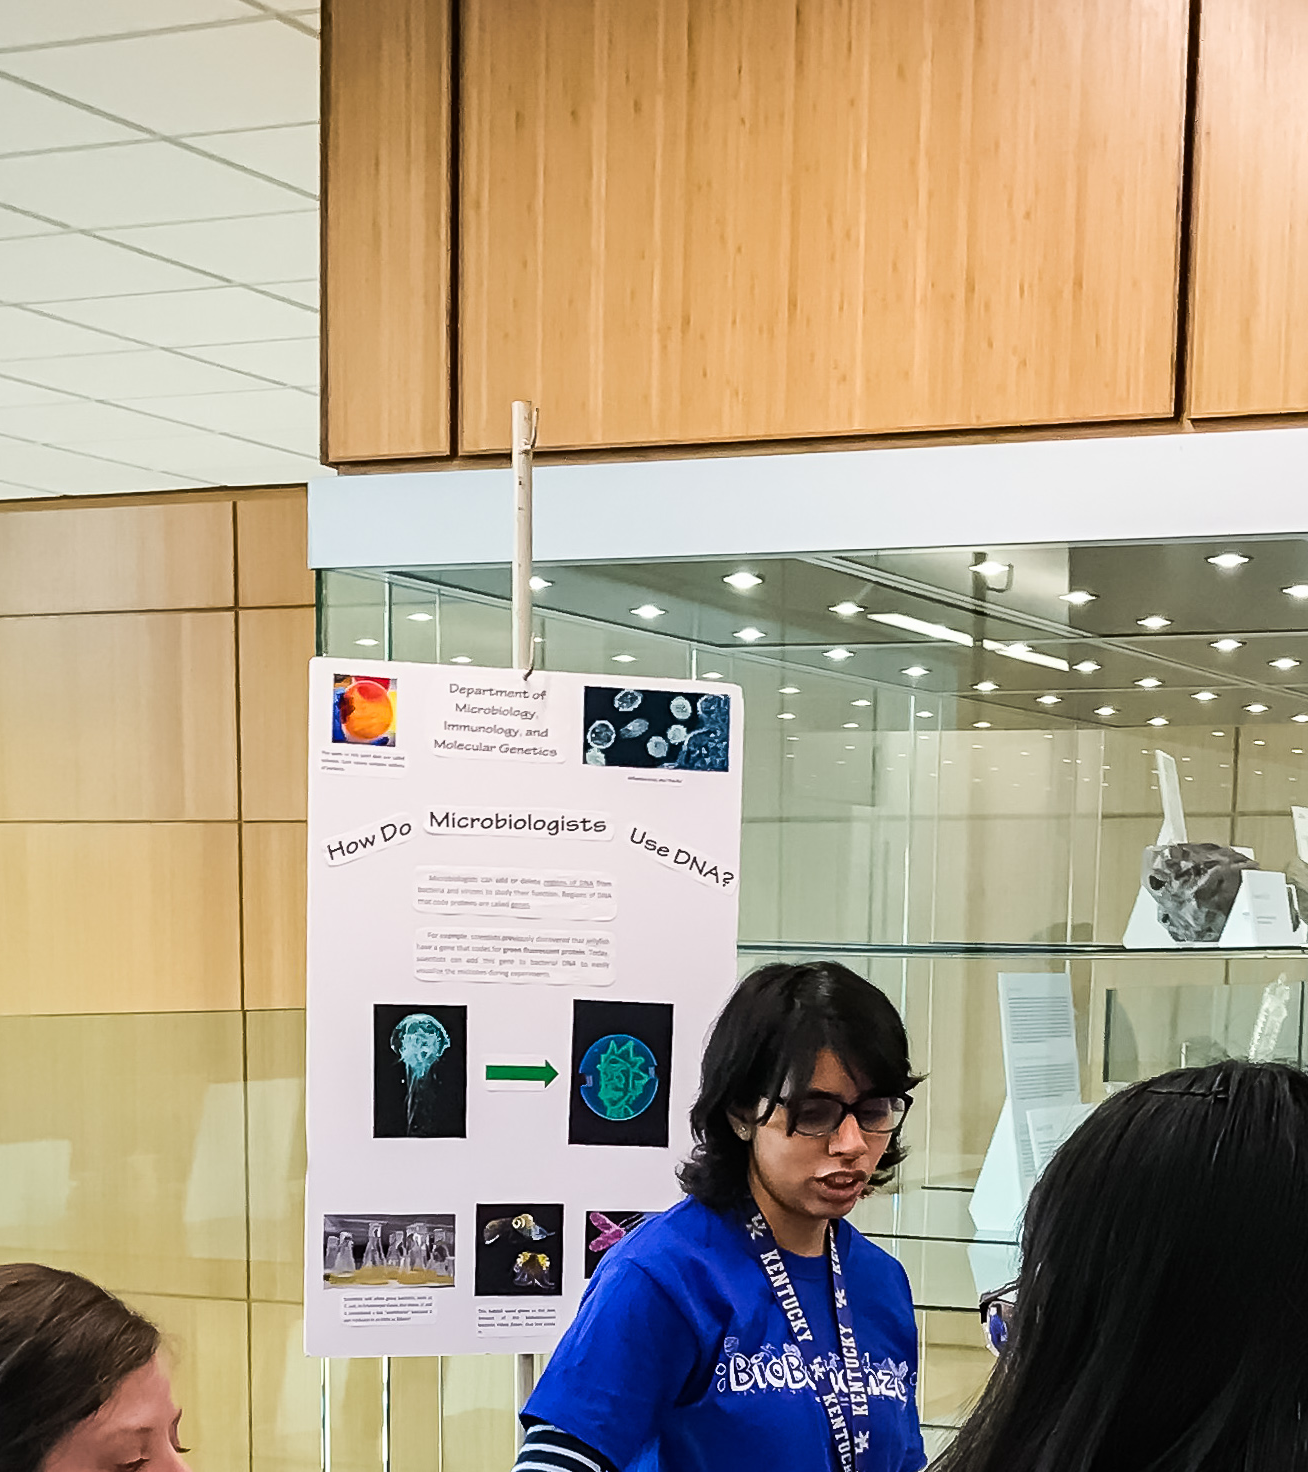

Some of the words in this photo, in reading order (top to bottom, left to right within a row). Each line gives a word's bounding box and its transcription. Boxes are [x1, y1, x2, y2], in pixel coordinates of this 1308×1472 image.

[449, 683, 529, 699] Department
[532, 689, 547, 700] of
[455, 703, 539, 720] Microbiology,
[443, 720, 523, 738] Immunology,
[525, 728, 549, 738] and
[433, 739, 496, 752] Molecular
[499, 743, 558, 757] Genetics
[326, 830, 376, 862] How
[380, 819, 413, 846] Do
[429, 810, 607, 836] Microbiologists
[629, 826, 670, 858] Use
[672, 848, 735, 889] DNA?
[760, 1249, 813, 1343] KENTUCKY
[838, 1323, 870, 1416] KENTUCKY
